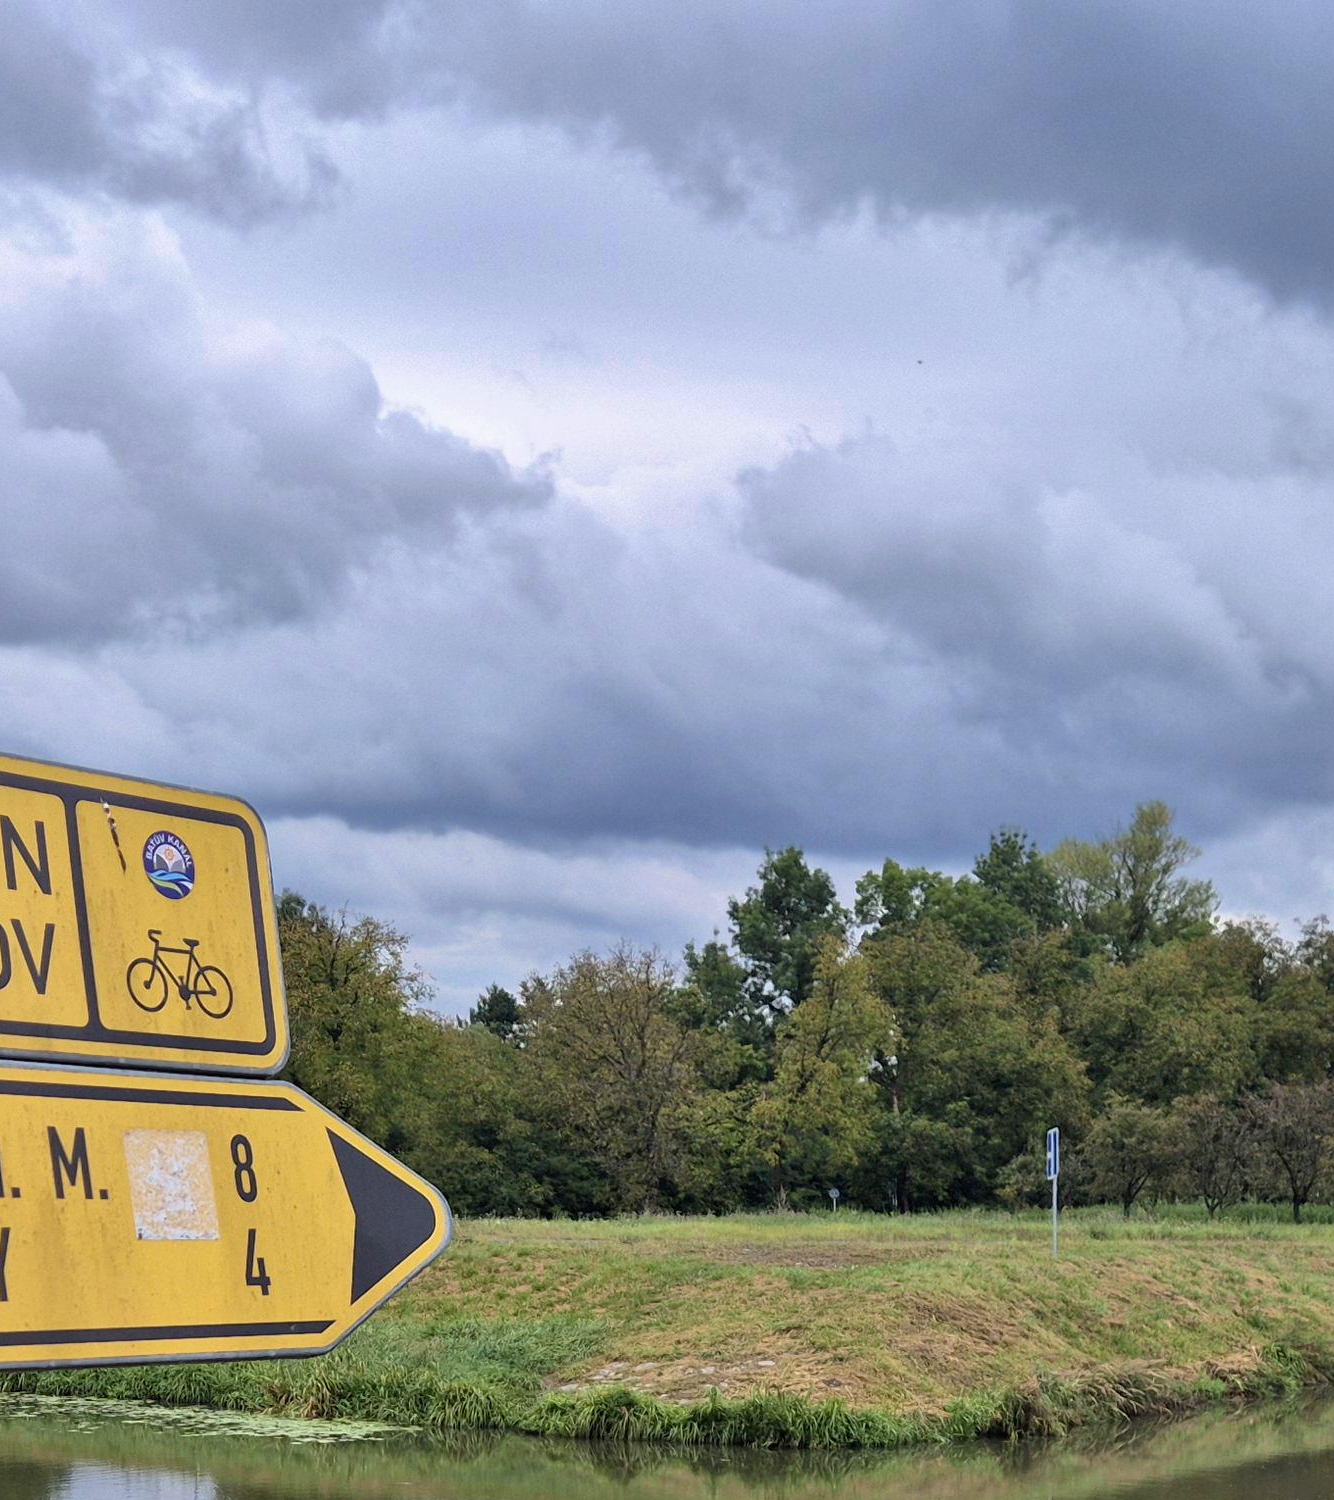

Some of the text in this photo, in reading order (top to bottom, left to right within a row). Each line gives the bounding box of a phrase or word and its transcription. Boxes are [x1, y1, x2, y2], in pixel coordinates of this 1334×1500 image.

[48, 1126, 109, 1200] M.
[230, 1134, 258, 1203] 8
[245, 1229, 271, 1296] 4
